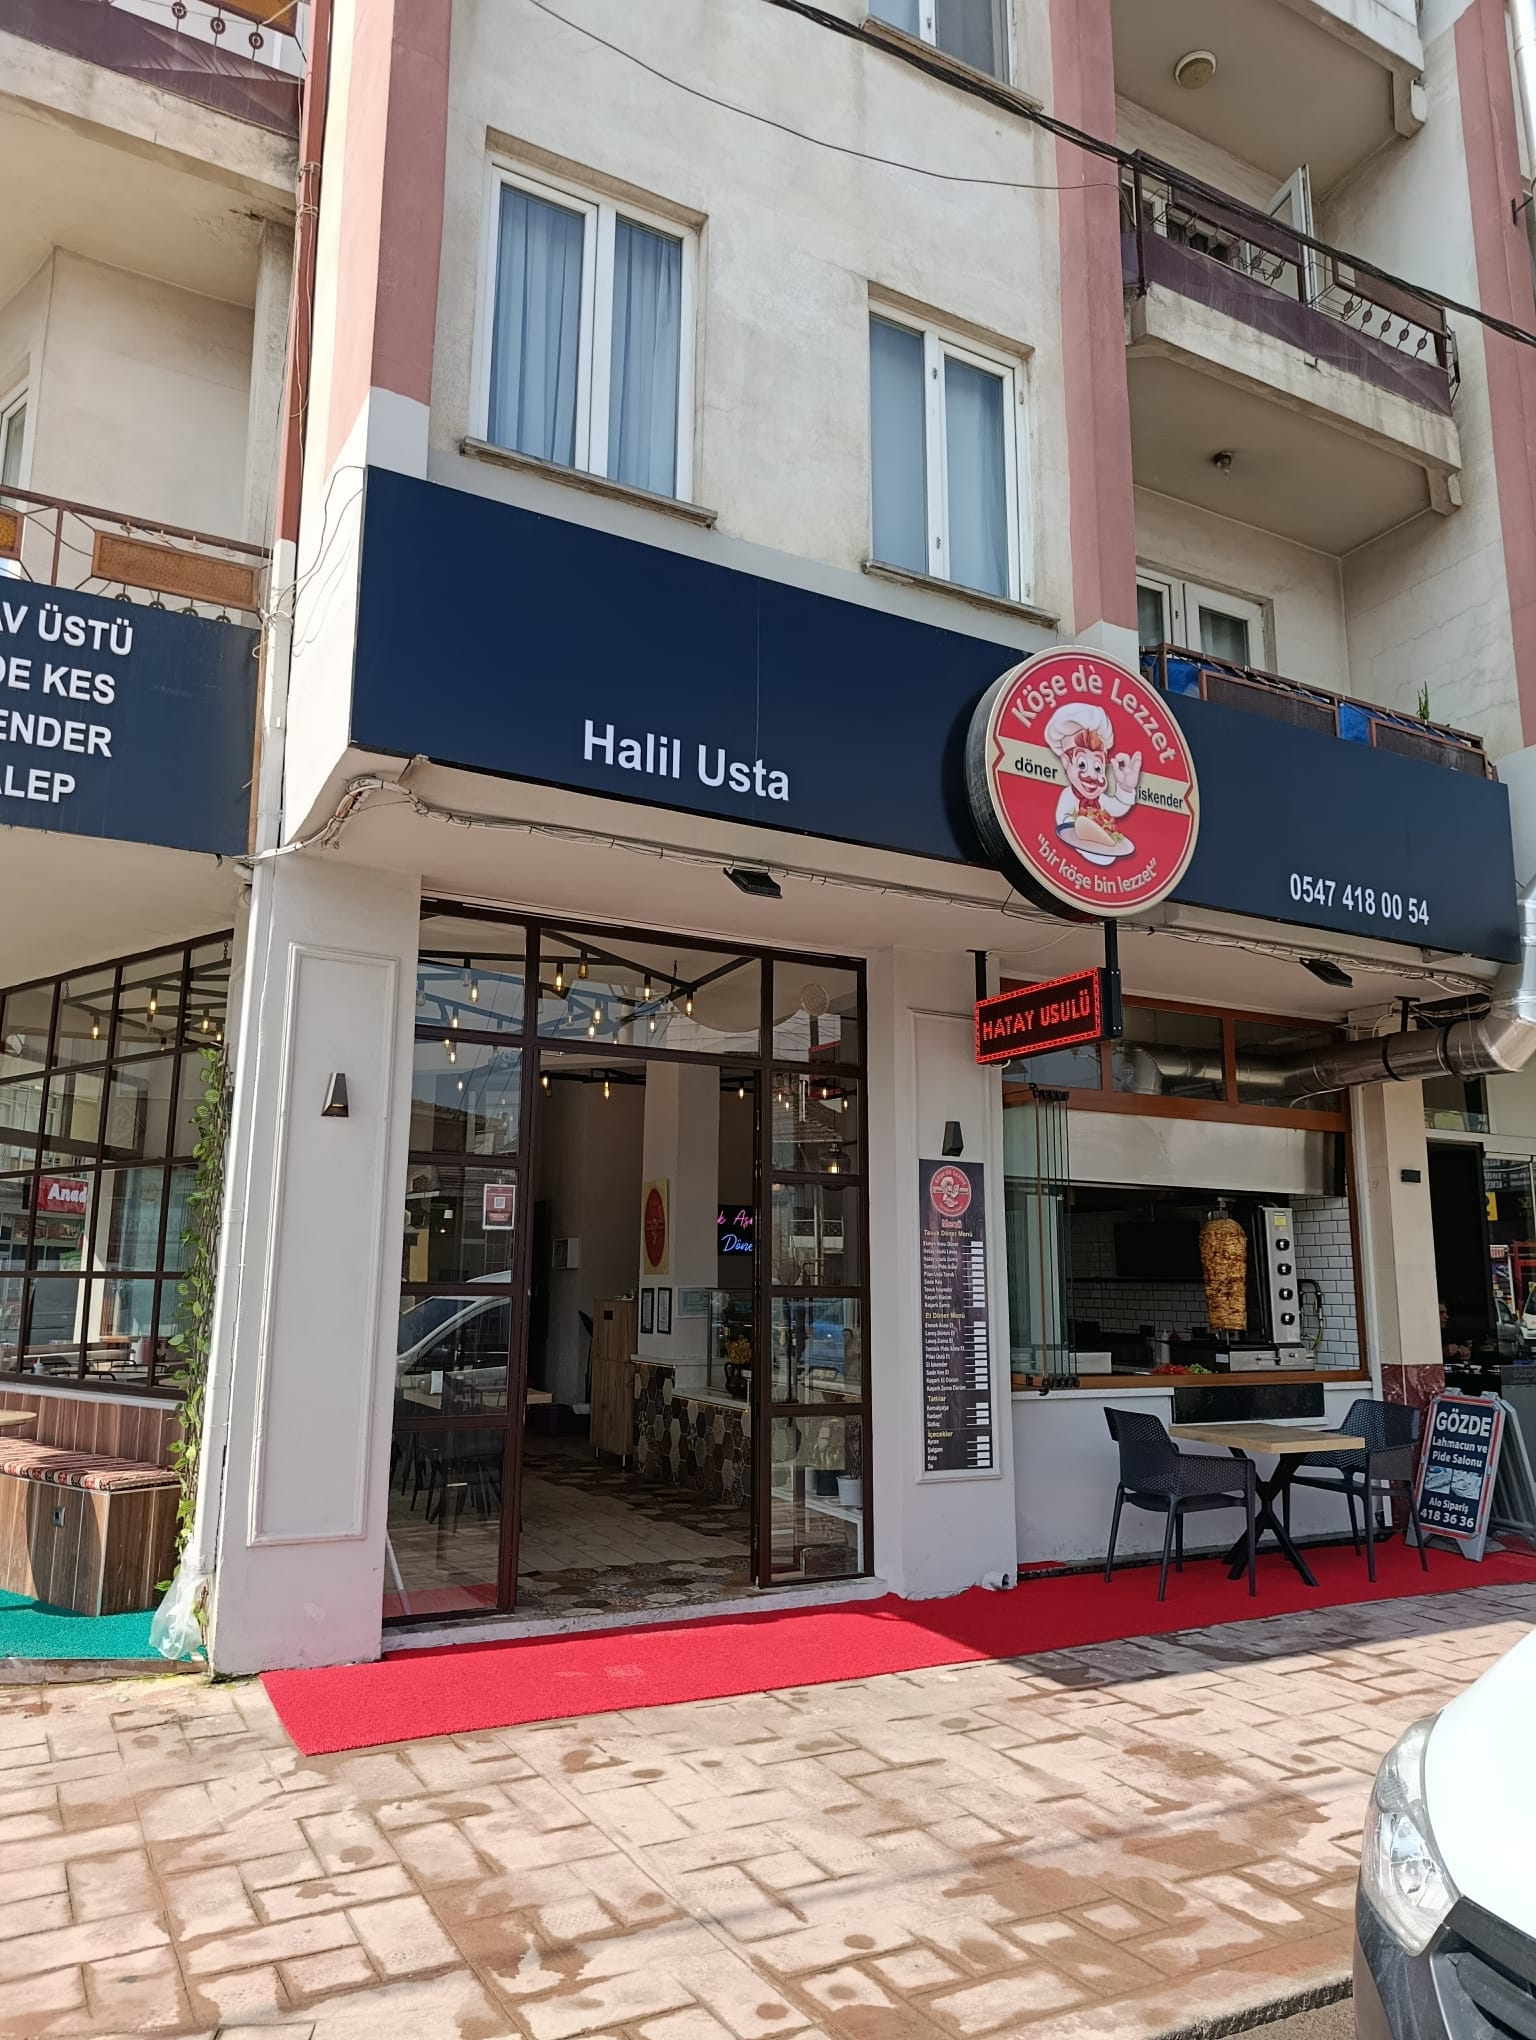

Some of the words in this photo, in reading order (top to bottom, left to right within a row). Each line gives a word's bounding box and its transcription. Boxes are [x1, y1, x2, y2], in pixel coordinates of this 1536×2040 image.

[0, 601, 29, 634] V
[38, 602, 134, 656] ÜSTÜ
[43, 664, 116, 705] KES
[1011, 675, 1068, 729] Köşe
[1110, 677, 1177, 765] Lezzet
[583, 719, 681, 779] Halil
[698, 743, 790, 801] Usta
[1014, 756, 1058, 780] döner
[0, 765, 77, 804] LEP
[1137, 785, 1184, 810] iskender
[1058, 858, 1092, 891] köşe
[1094, 872, 1117, 895] bin
[1290, 873, 1337, 908] 0547
[1342, 884, 1376, 915] 418
[1381, 891, 1402, 921] 00
[1408, 897, 1430, 926] 54
[983, 1009, 1035, 1041] HATAY
[1040, 989, 1091, 1026] USULÜ
[1436, 1408, 1492, 1438] GÖZDE
[1432, 1436, 1476, 1452] Lahmacun
[1477, 1445, 1488, 1454] ve
[1432, 1450, 1450, 1463] Pide
[1452, 1454, 1483, 1468] Salonu
[1420, 1508, 1440, 1521] 418
[1443, 1511, 1457, 1525] 36
[1459, 1515, 1475, 1528] 36
[1429, 1497, 1442, 1507] Alo
[1443, 1499, 1469, 1513] Sipariş
